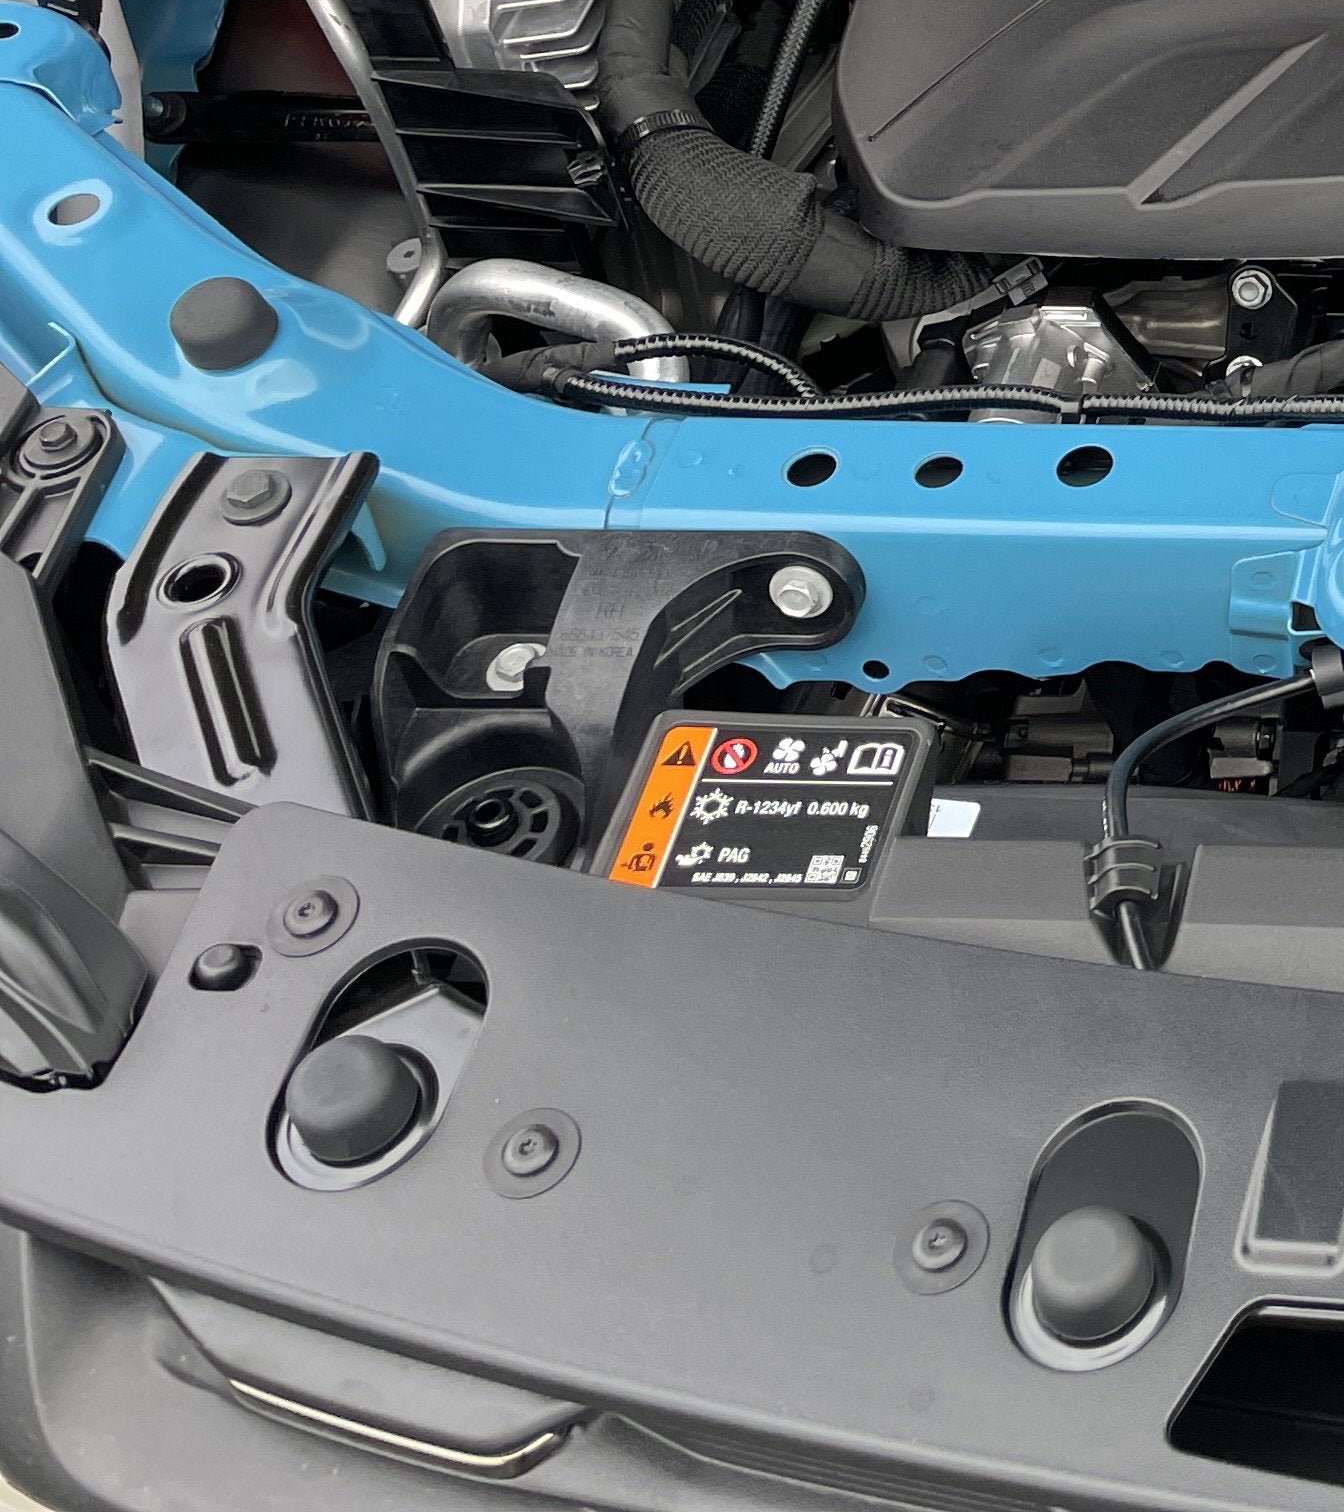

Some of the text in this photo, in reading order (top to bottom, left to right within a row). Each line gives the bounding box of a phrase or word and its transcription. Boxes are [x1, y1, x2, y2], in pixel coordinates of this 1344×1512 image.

[599, 646, 633, 657] KOREA
[763, 761, 800, 775] AUTO
[735, 800, 870, 819] R-1234yf 0.600 kg
[717, 847, 751, 863] PAG
